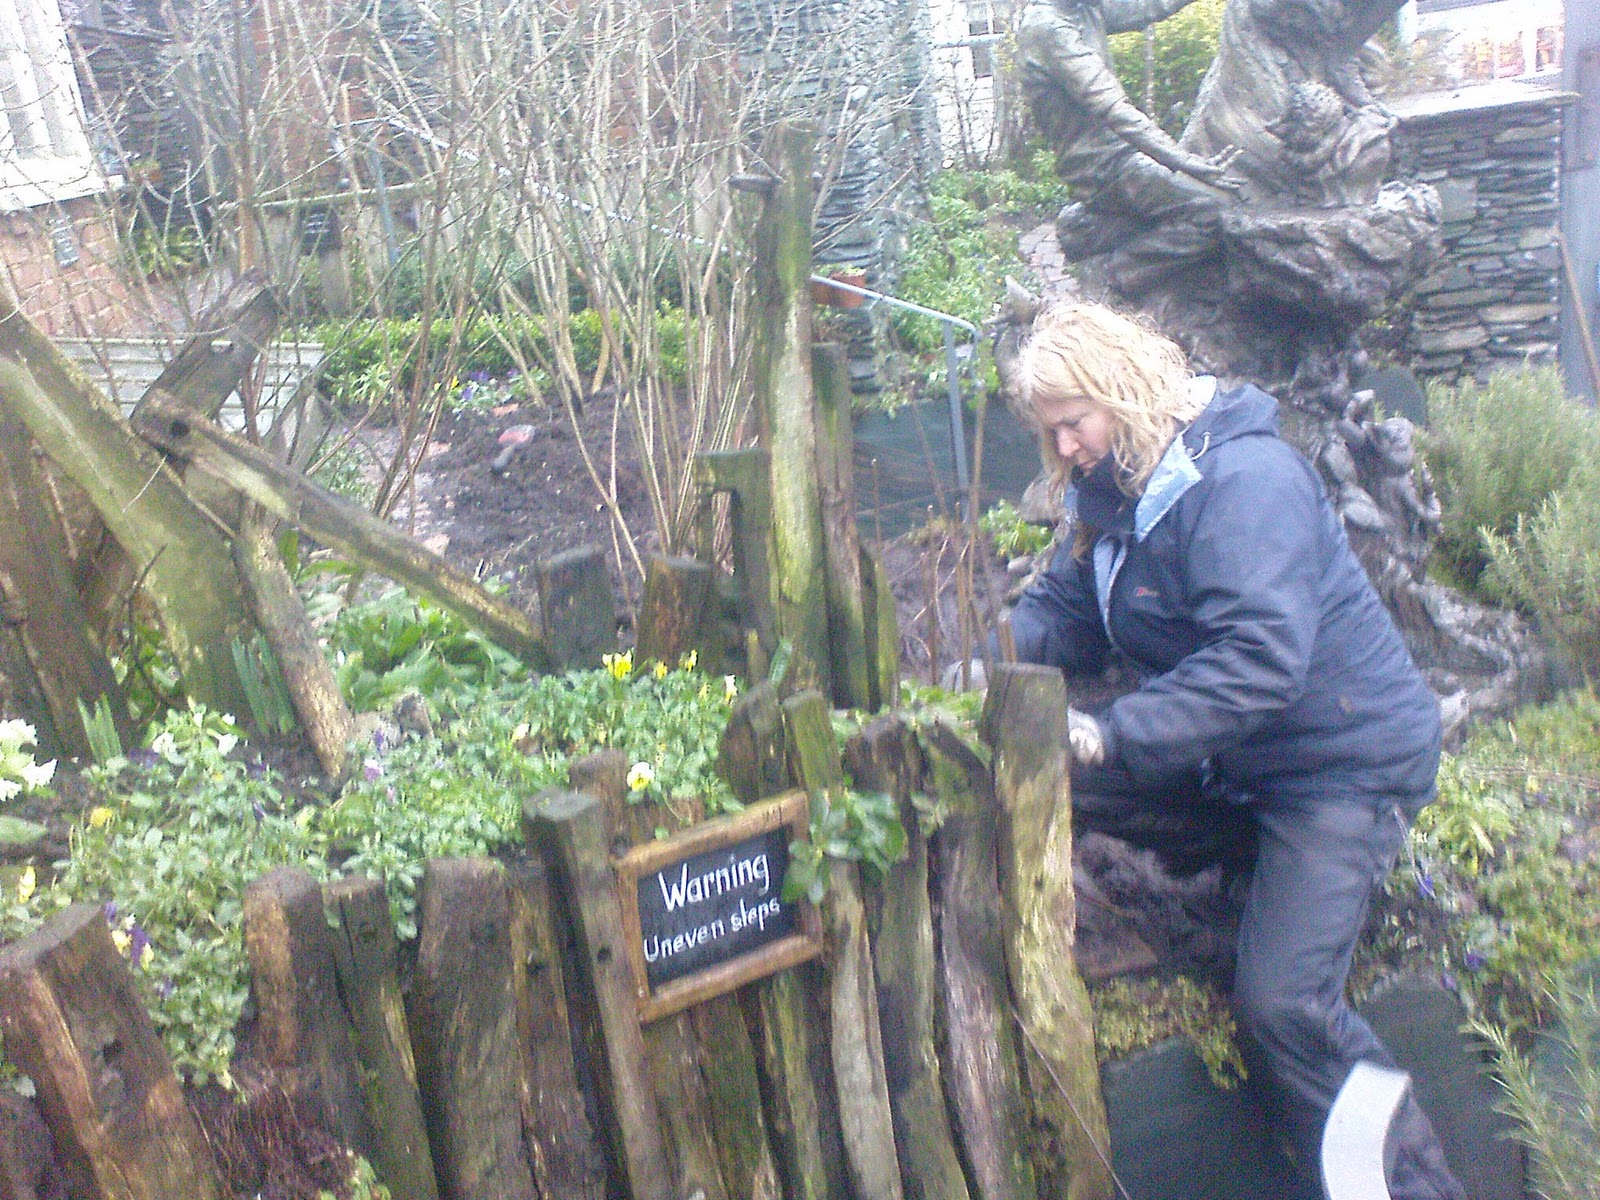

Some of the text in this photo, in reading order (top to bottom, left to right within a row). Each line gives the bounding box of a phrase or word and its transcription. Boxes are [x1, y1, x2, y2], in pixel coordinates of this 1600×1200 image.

[658, 853, 770, 912] Warning
[643, 897, 781, 963] Uneven steps
